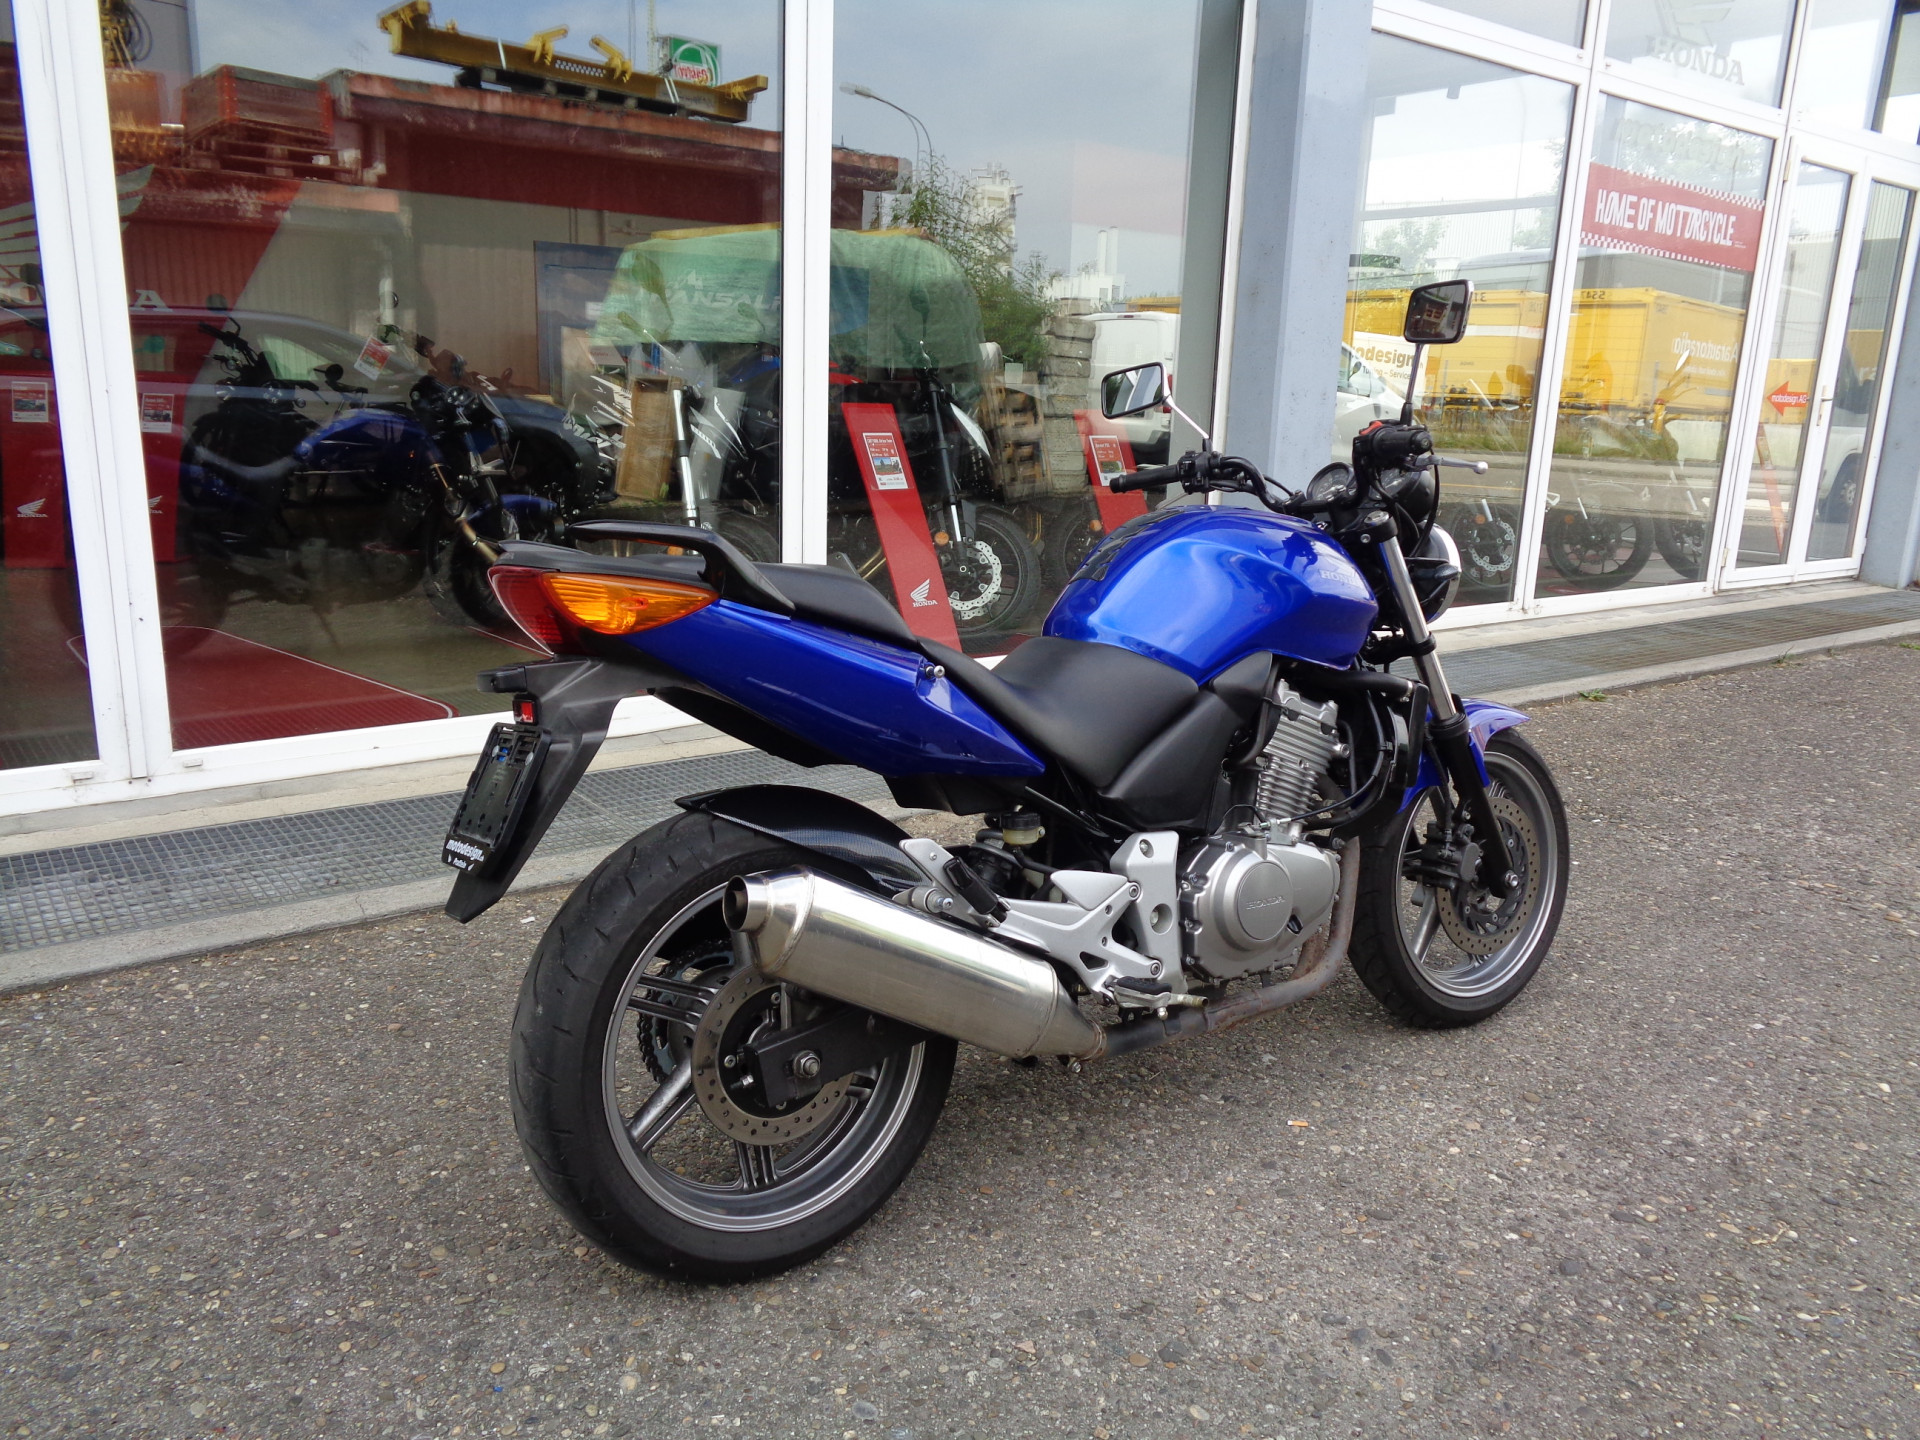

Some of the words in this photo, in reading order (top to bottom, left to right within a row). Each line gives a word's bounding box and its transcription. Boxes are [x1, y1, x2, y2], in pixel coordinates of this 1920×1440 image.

[1651, 37, 1745, 86] HONDA
[1594, 188, 1638, 229] HOME
[1637, 197, 1656, 231] OF
[1771, 393, 1798, 405] motodesign
[912, 599, 938, 608] HONDA
[1246, 896, 1286, 910] HONDA
